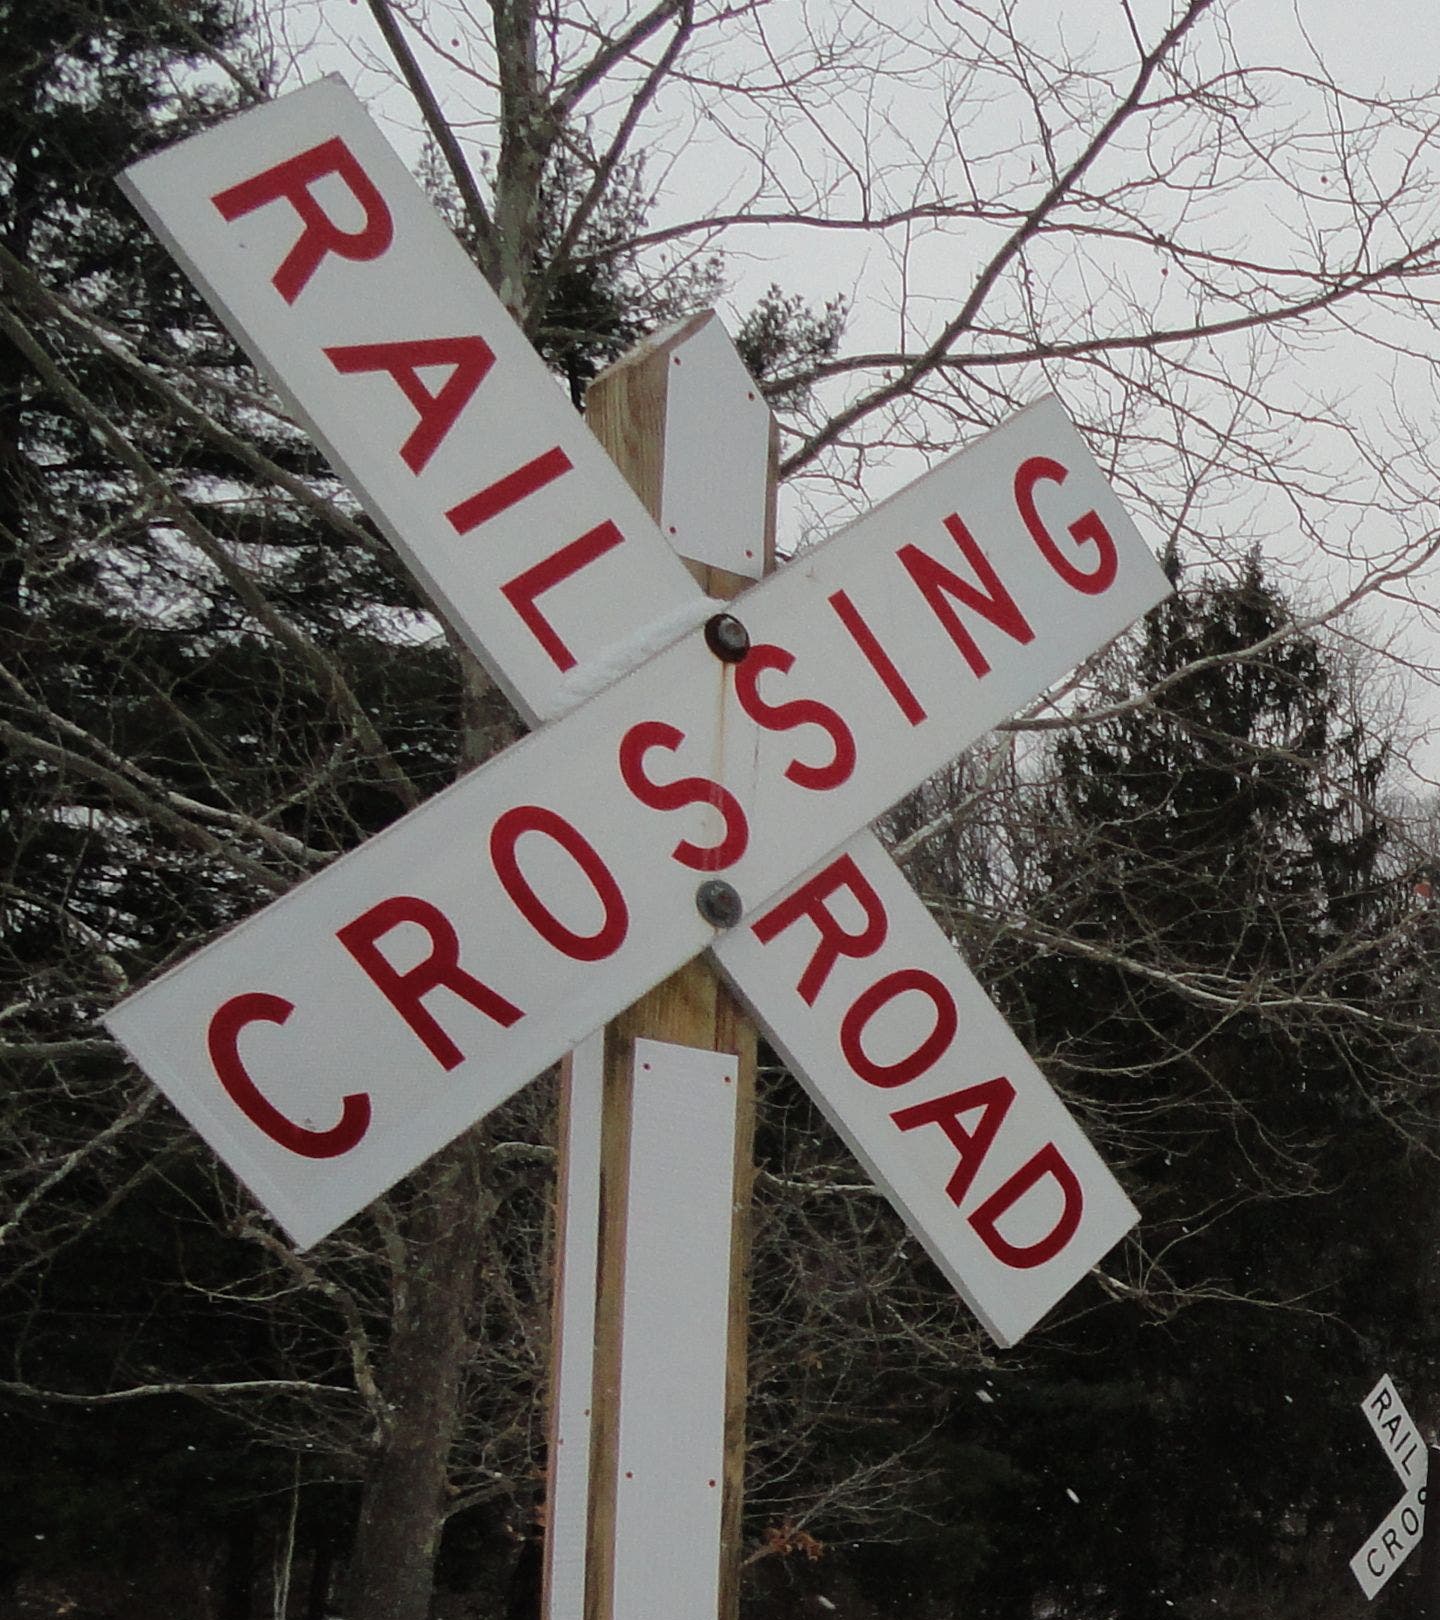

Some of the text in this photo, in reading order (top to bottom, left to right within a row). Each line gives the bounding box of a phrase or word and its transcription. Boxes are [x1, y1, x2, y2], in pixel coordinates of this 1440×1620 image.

[207, 456, 1119, 1158] CROSSING
[212, 137, 1084, 1271] RAIL ROAD
[1371, 1387, 1418, 1476] RAIL
